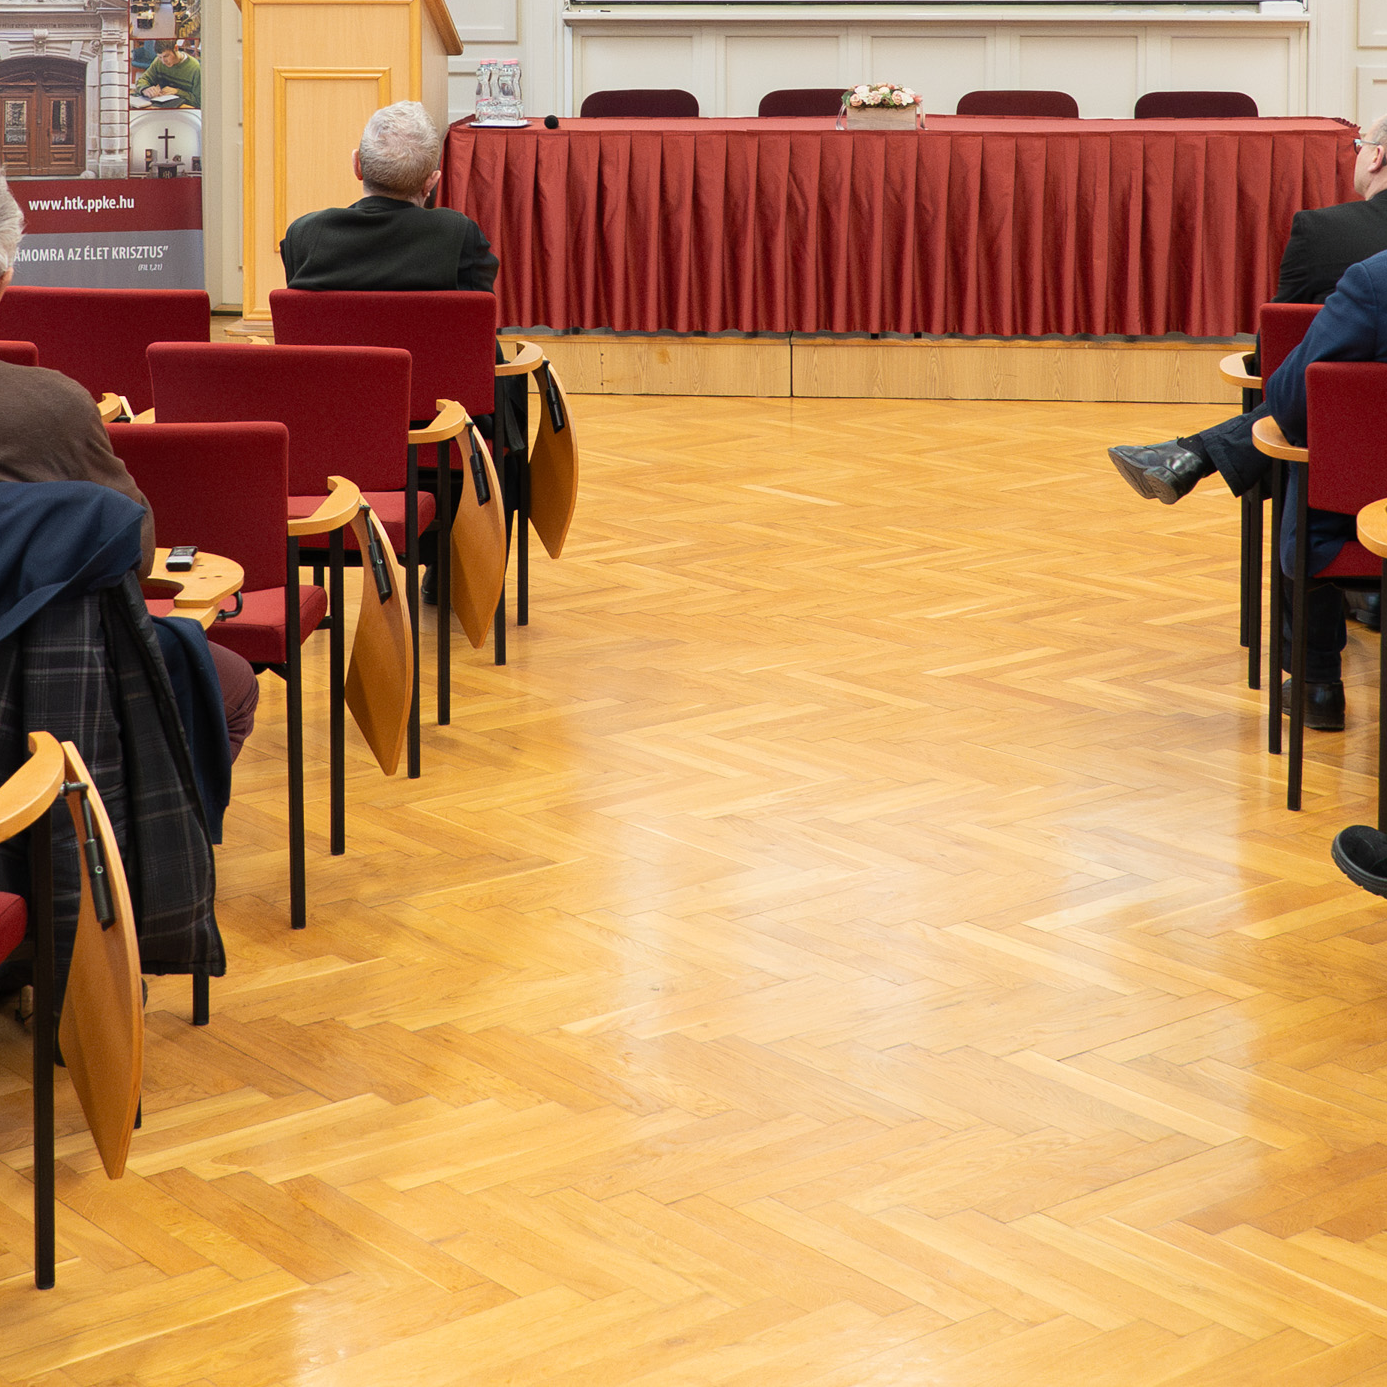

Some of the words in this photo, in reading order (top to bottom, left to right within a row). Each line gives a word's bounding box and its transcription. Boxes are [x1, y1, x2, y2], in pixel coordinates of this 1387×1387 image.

[28, 195, 135, 213] www.htk.ppke.hu
[67, 247, 82, 261] AZ
[84, 244, 110, 261] ÉLET
